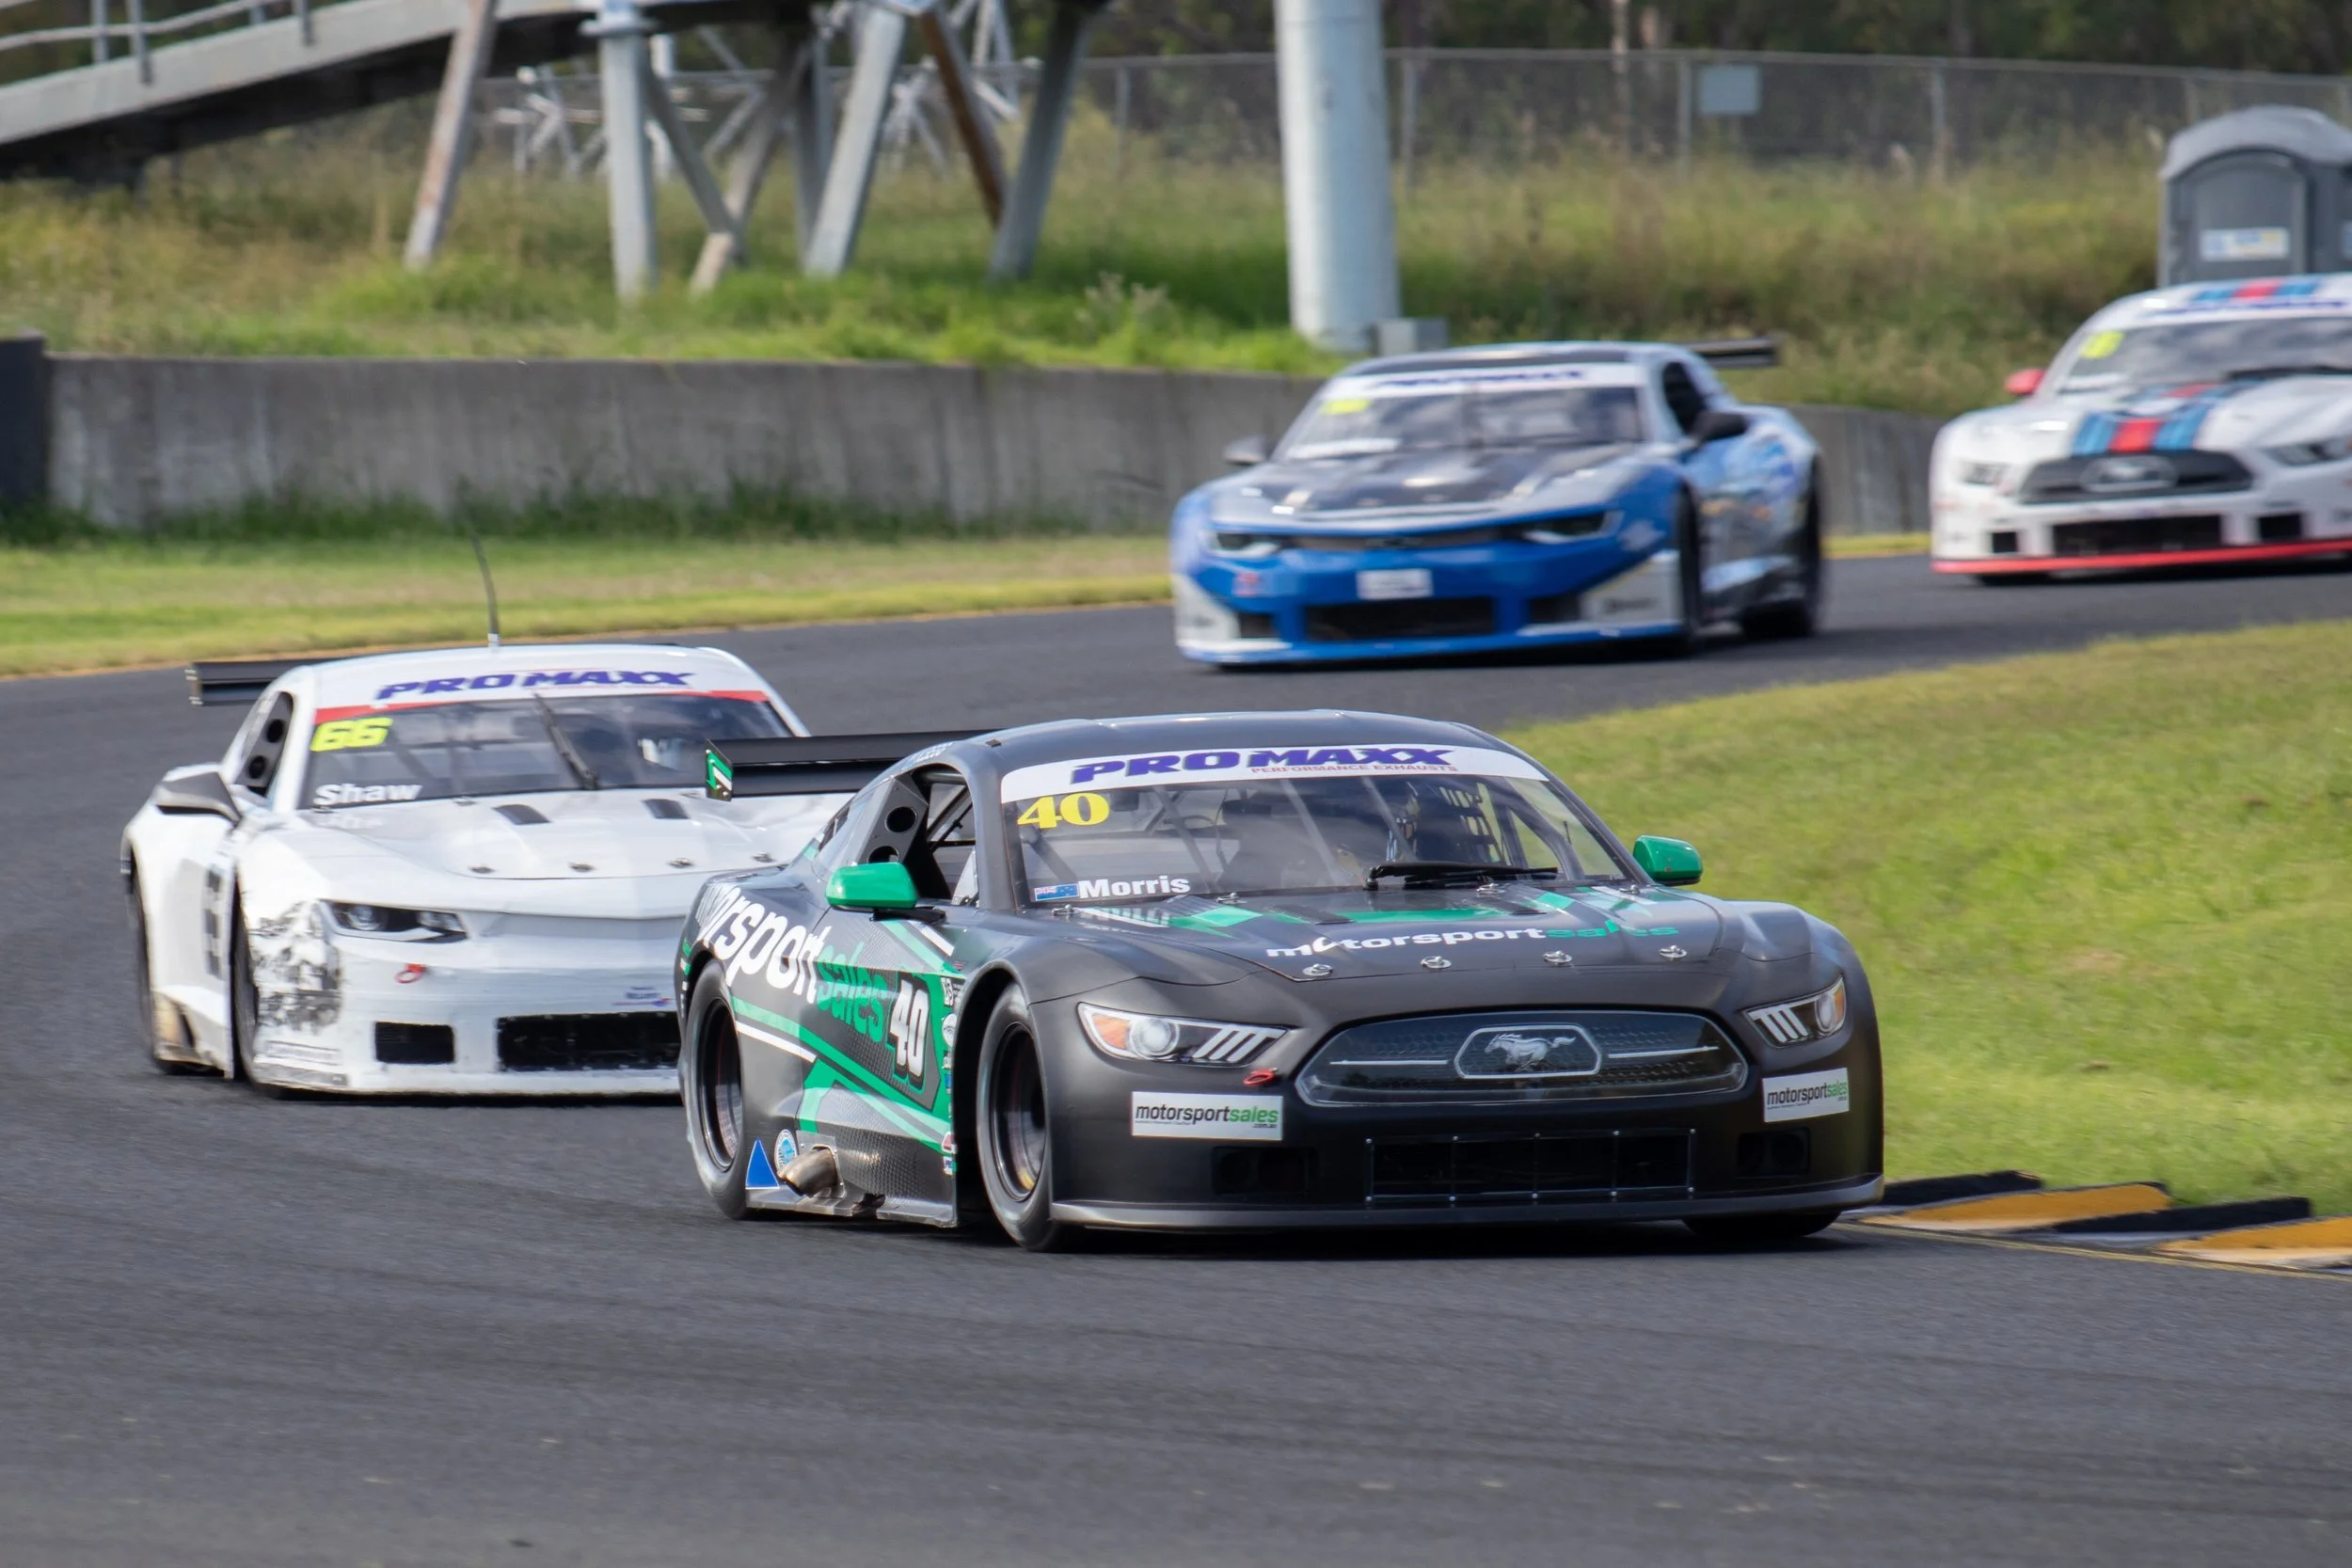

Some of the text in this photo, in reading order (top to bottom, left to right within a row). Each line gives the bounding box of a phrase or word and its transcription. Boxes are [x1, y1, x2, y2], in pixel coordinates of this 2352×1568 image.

[375, 671, 697, 700] PRO MAXX
[310, 717, 393, 752] 66
[1070, 748, 1457, 784] PRO MAXX
[1250, 763, 1459, 774] PERFORMANCE EXHAUSTS
[313, 783, 423, 805] Shaw
[1016, 792, 1110, 829] 40
[1078, 875, 1191, 899] Morris
[889, 977, 930, 1078] 40
[1767, 1079, 1848, 1105] motorsportsales
[1135, 1103, 1279, 1125] motorsportsales
